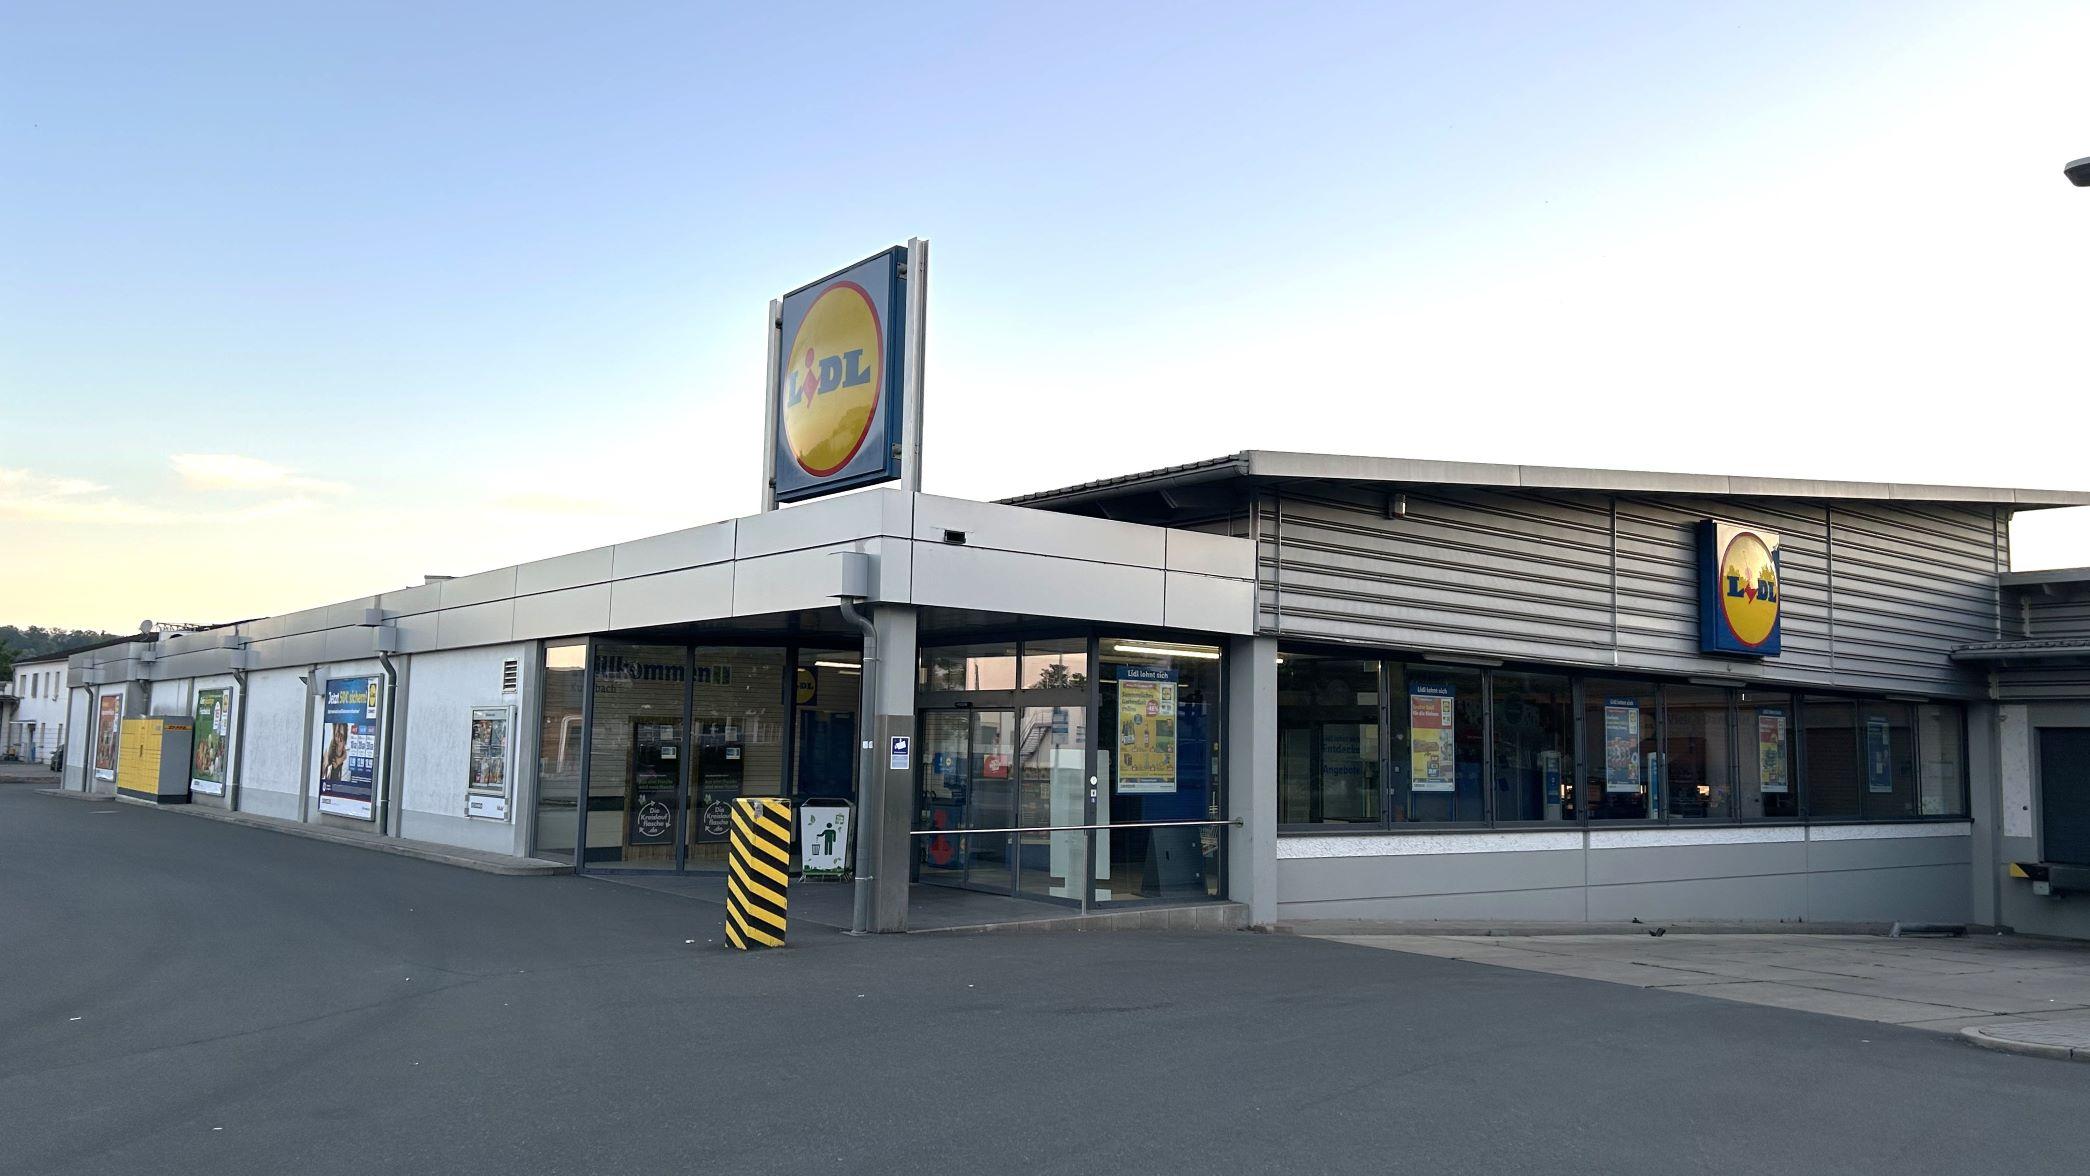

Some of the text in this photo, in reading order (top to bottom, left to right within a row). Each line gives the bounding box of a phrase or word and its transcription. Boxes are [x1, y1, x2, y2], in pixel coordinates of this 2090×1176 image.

[787, 347, 871, 409] LIDL
[1127, 669, 1169, 679] Lidl lohnt sich
